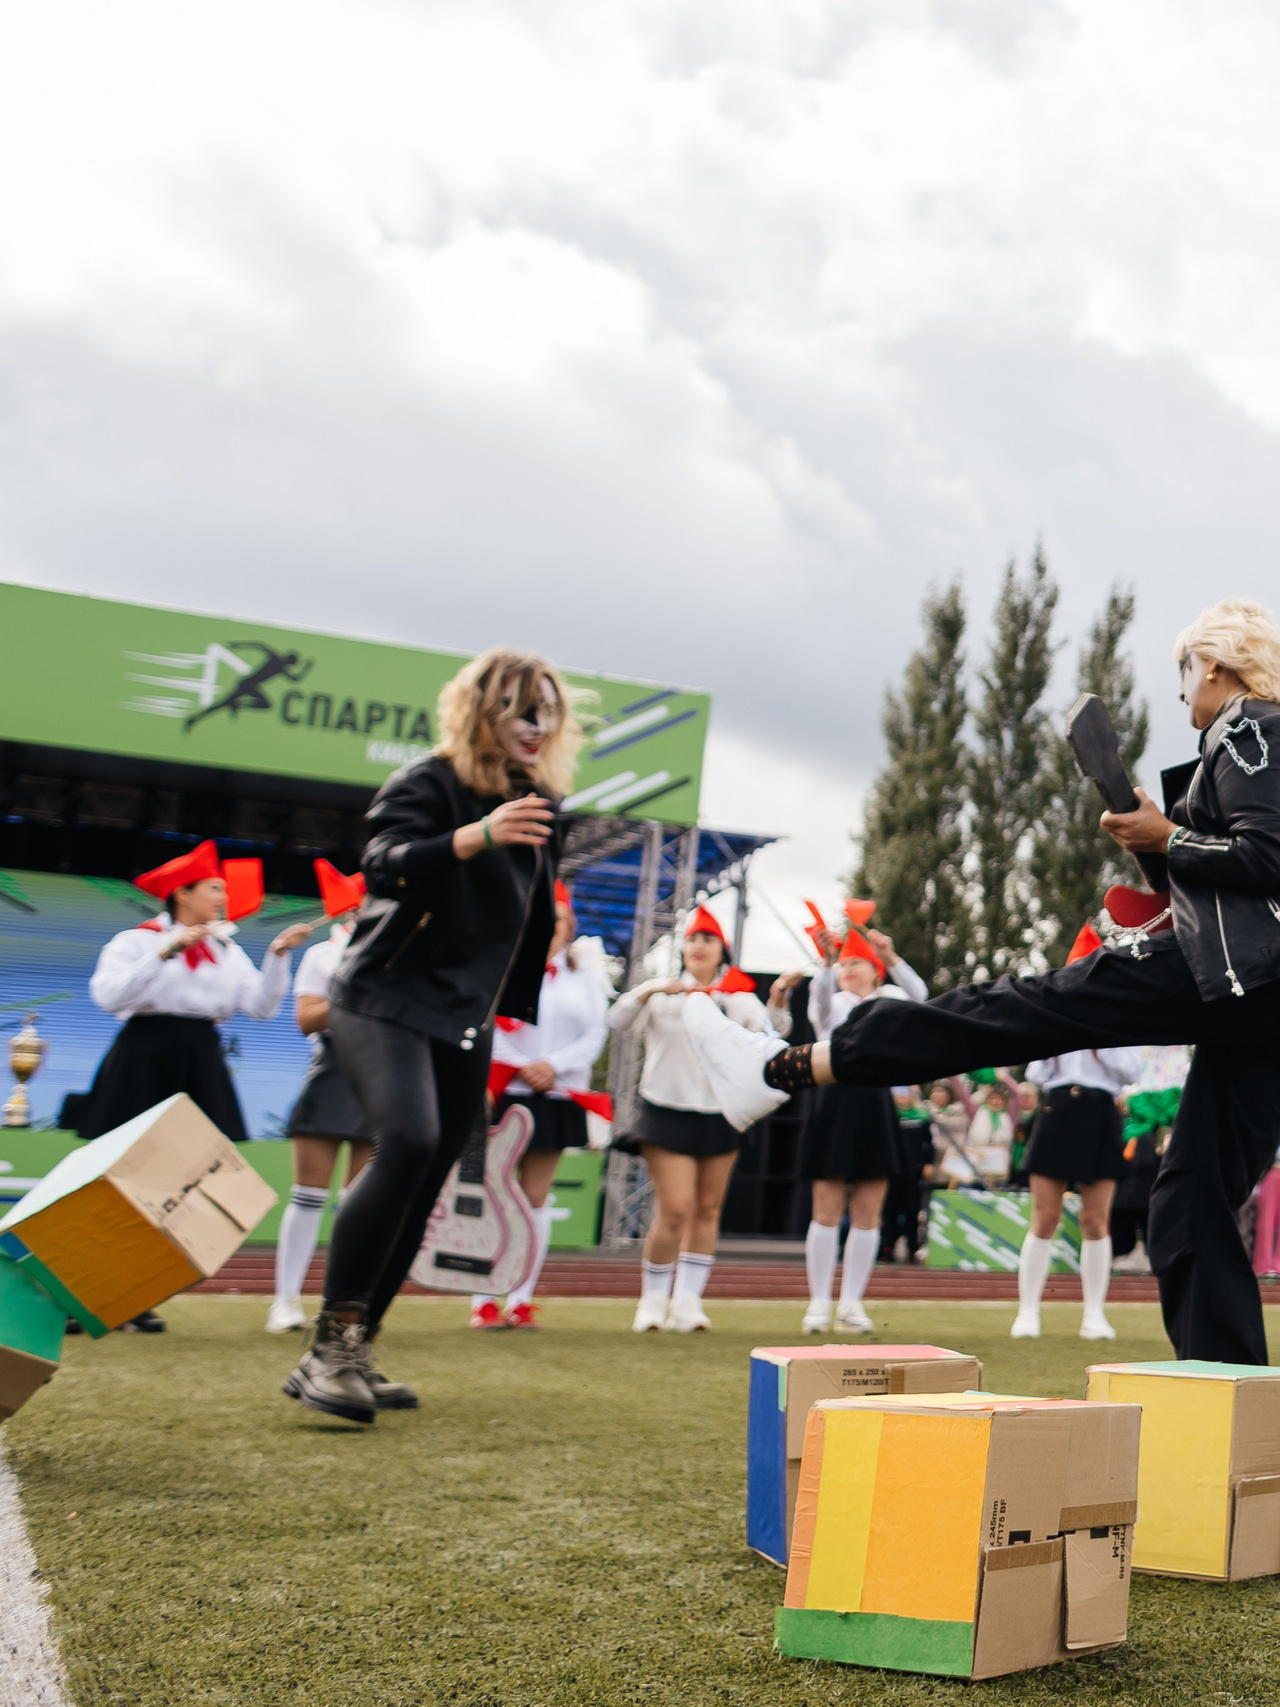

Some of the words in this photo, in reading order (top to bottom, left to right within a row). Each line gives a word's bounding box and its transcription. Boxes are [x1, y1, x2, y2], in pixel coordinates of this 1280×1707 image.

[865, 1368, 879, 1376] 250
[1000, 1498, 1007, 1514] BF
[989, 1500, 999, 1539] 245mm
